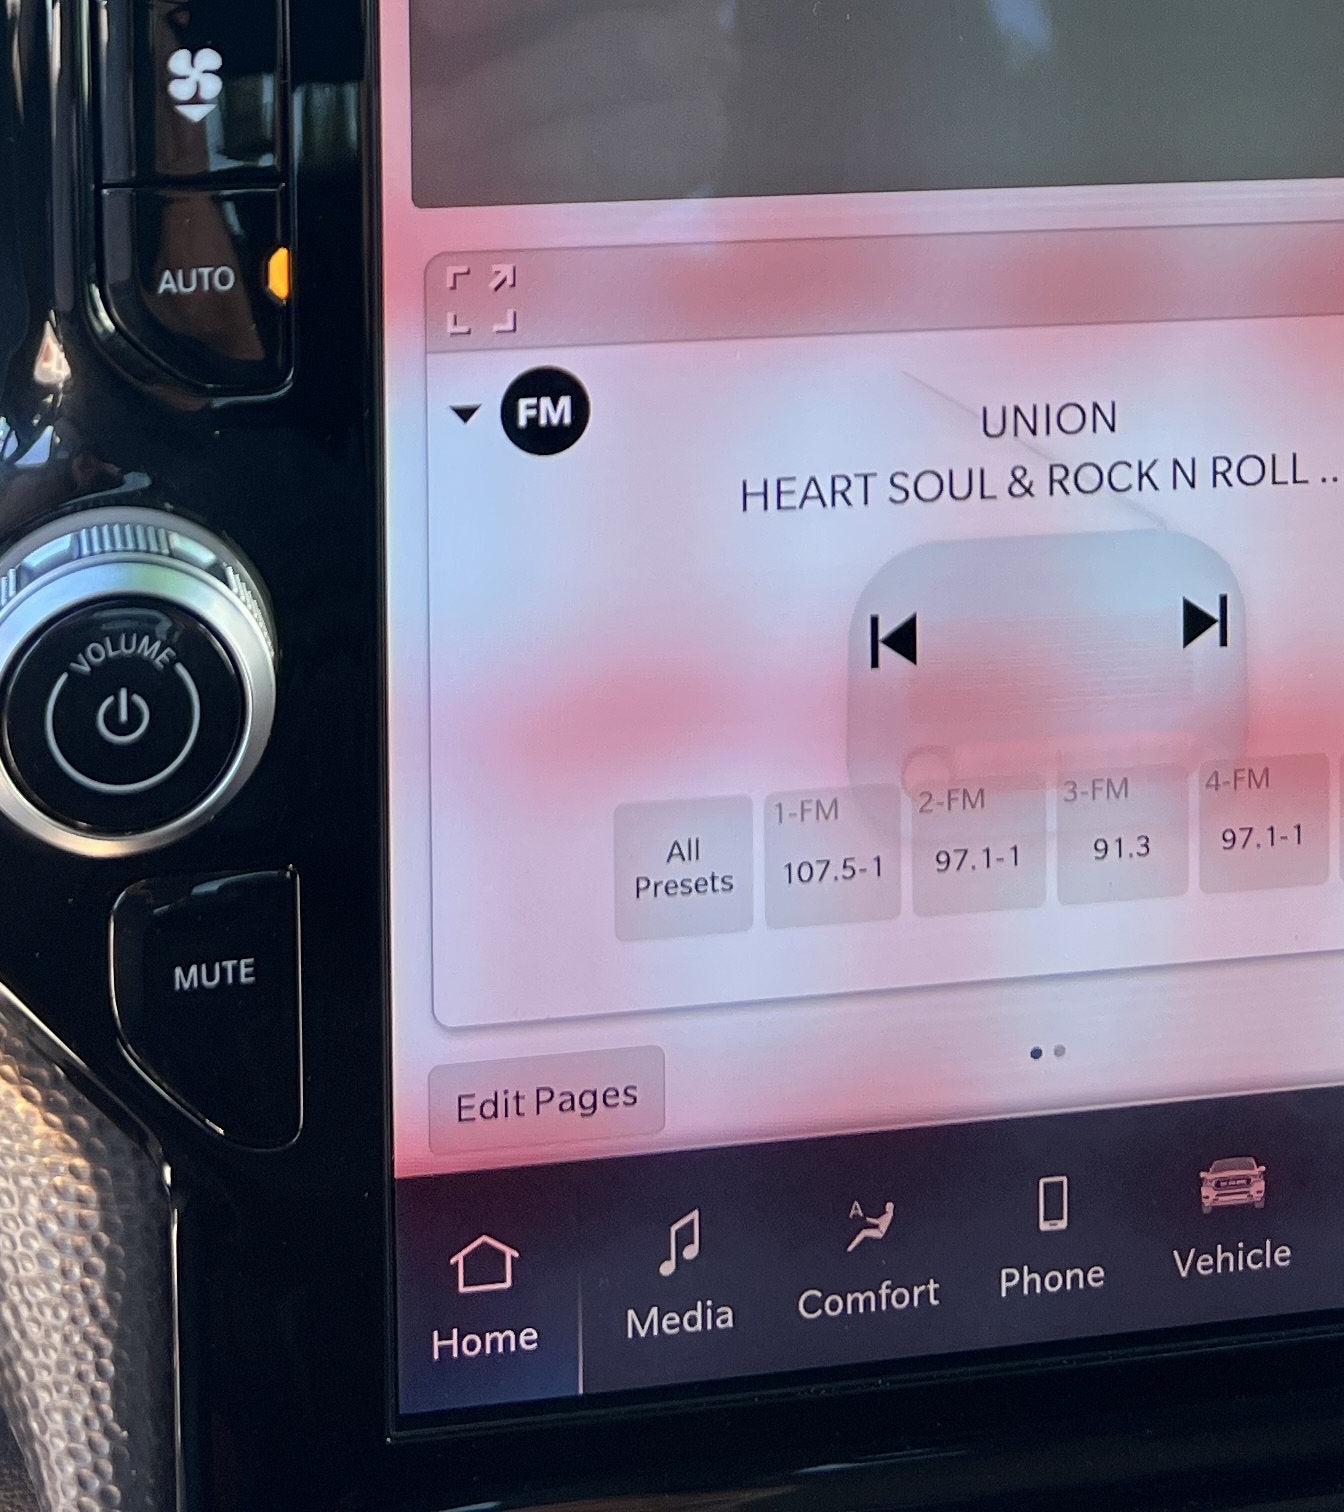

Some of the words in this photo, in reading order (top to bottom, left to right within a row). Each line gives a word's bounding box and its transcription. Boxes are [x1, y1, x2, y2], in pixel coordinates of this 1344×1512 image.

[157, 264, 236, 294] AUTO
[516, 395, 574, 430] FM
[980, 400, 1119, 442] UNION
[739, 470, 878, 515] HEART
[887, 465, 999, 506] SOUL
[1008, 464, 1037, 500] &
[1047, 458, 1162, 496] ROCK
[1172, 456, 1199, 492] N
[69, 632, 177, 678] VOLUME
[1062, 777, 1131, 806] 3-FM
[1205, 766, 1272, 794] 4-FM
[773, 797, 840, 826] 1-FM
[917, 787, 987, 816] 2-FM
[665, 838, 702, 865] All
[1092, 834, 1152, 863] 91.3
[1220, 823, 1305, 852] 97.1-1
[782, 854, 885, 887] 107.5-1
[934, 844, 1022, 874] 97.1-1
[634, 869, 735, 900] Presets
[173, 957, 256, 992] MUTE
[456, 1088, 526, 1124] Edit
[535, 1083, 639, 1118] Pages
[1172, 1239, 1292, 1279] Vehicle
[999, 1261, 1106, 1297] Phone
[797, 1278, 941, 1320] Comfort
[625, 1300, 735, 1340] Media
[431, 1325, 540, 1362] Home
